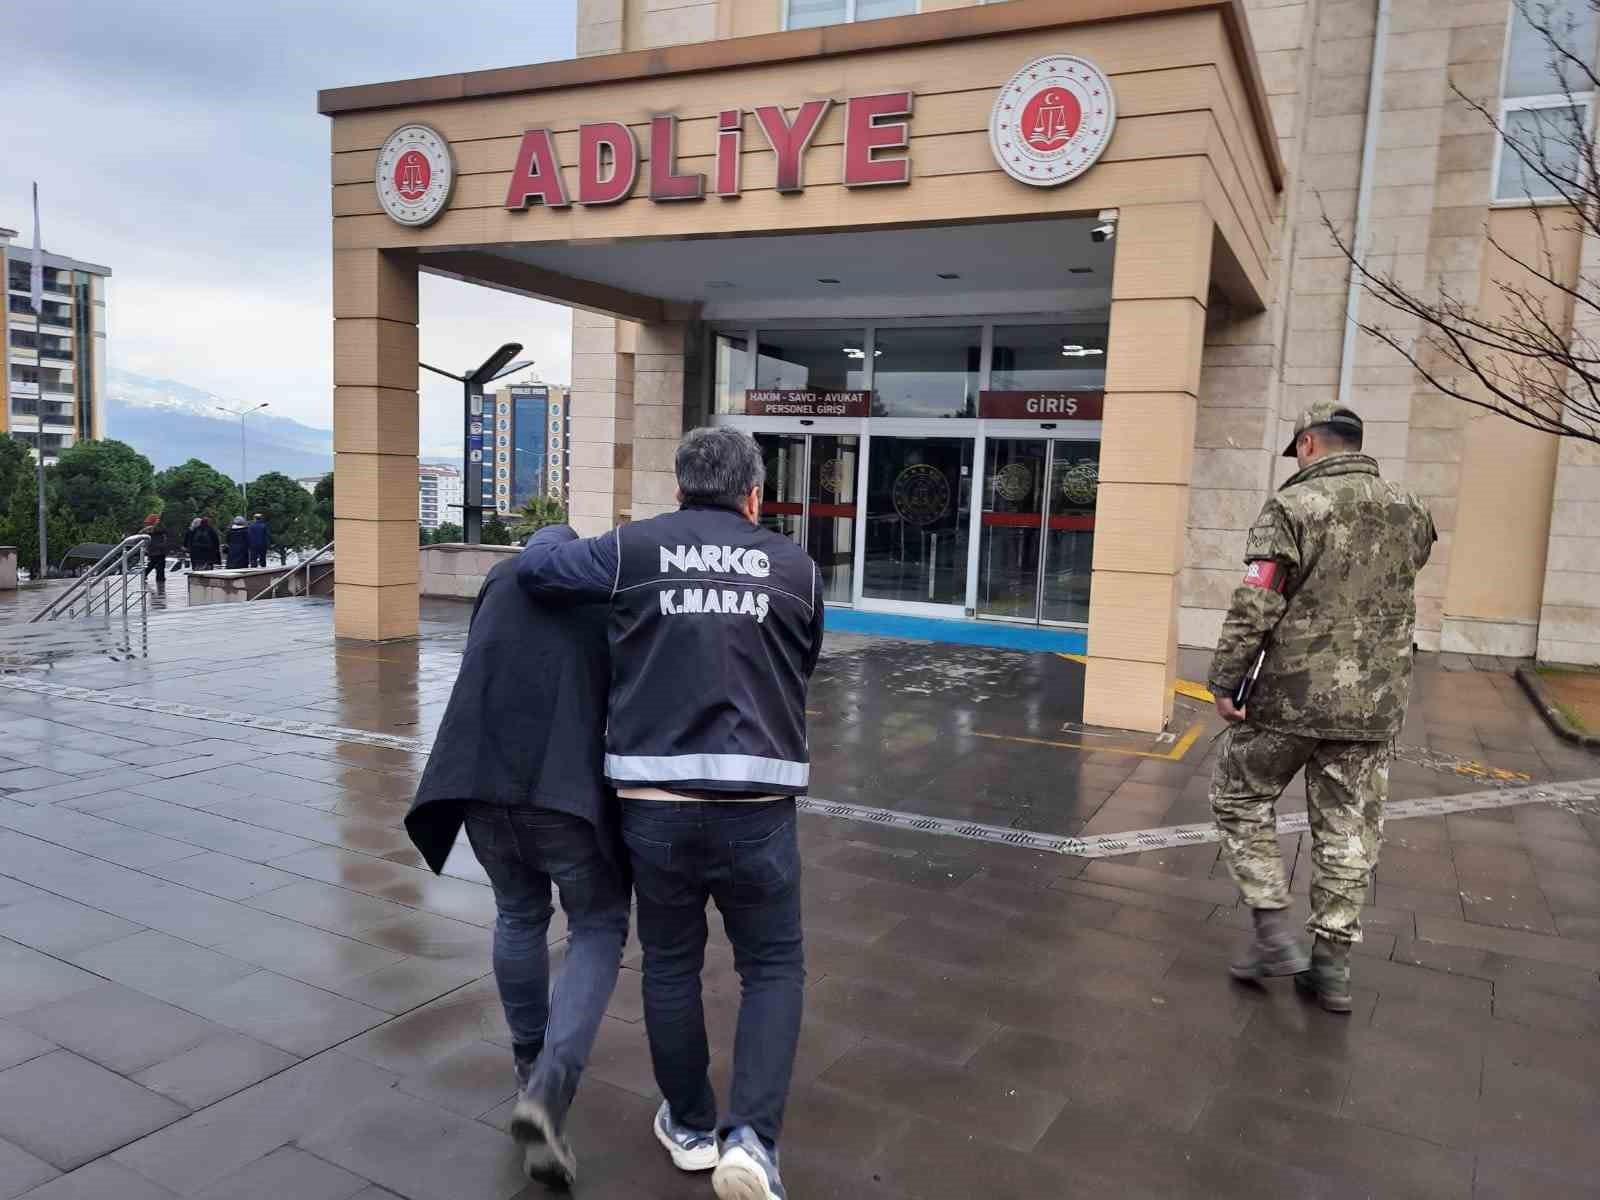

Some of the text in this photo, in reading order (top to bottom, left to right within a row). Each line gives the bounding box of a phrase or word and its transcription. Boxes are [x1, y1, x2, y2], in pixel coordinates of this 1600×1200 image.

[824, 392, 864, 403] AVUKAT
[1026, 394, 1078, 416] GİRİŞ
[766, 404, 816, 414] PERSONEL
[659, 544, 771, 578] NARKO
[659, 588, 770, 624] K.MARAŞ
